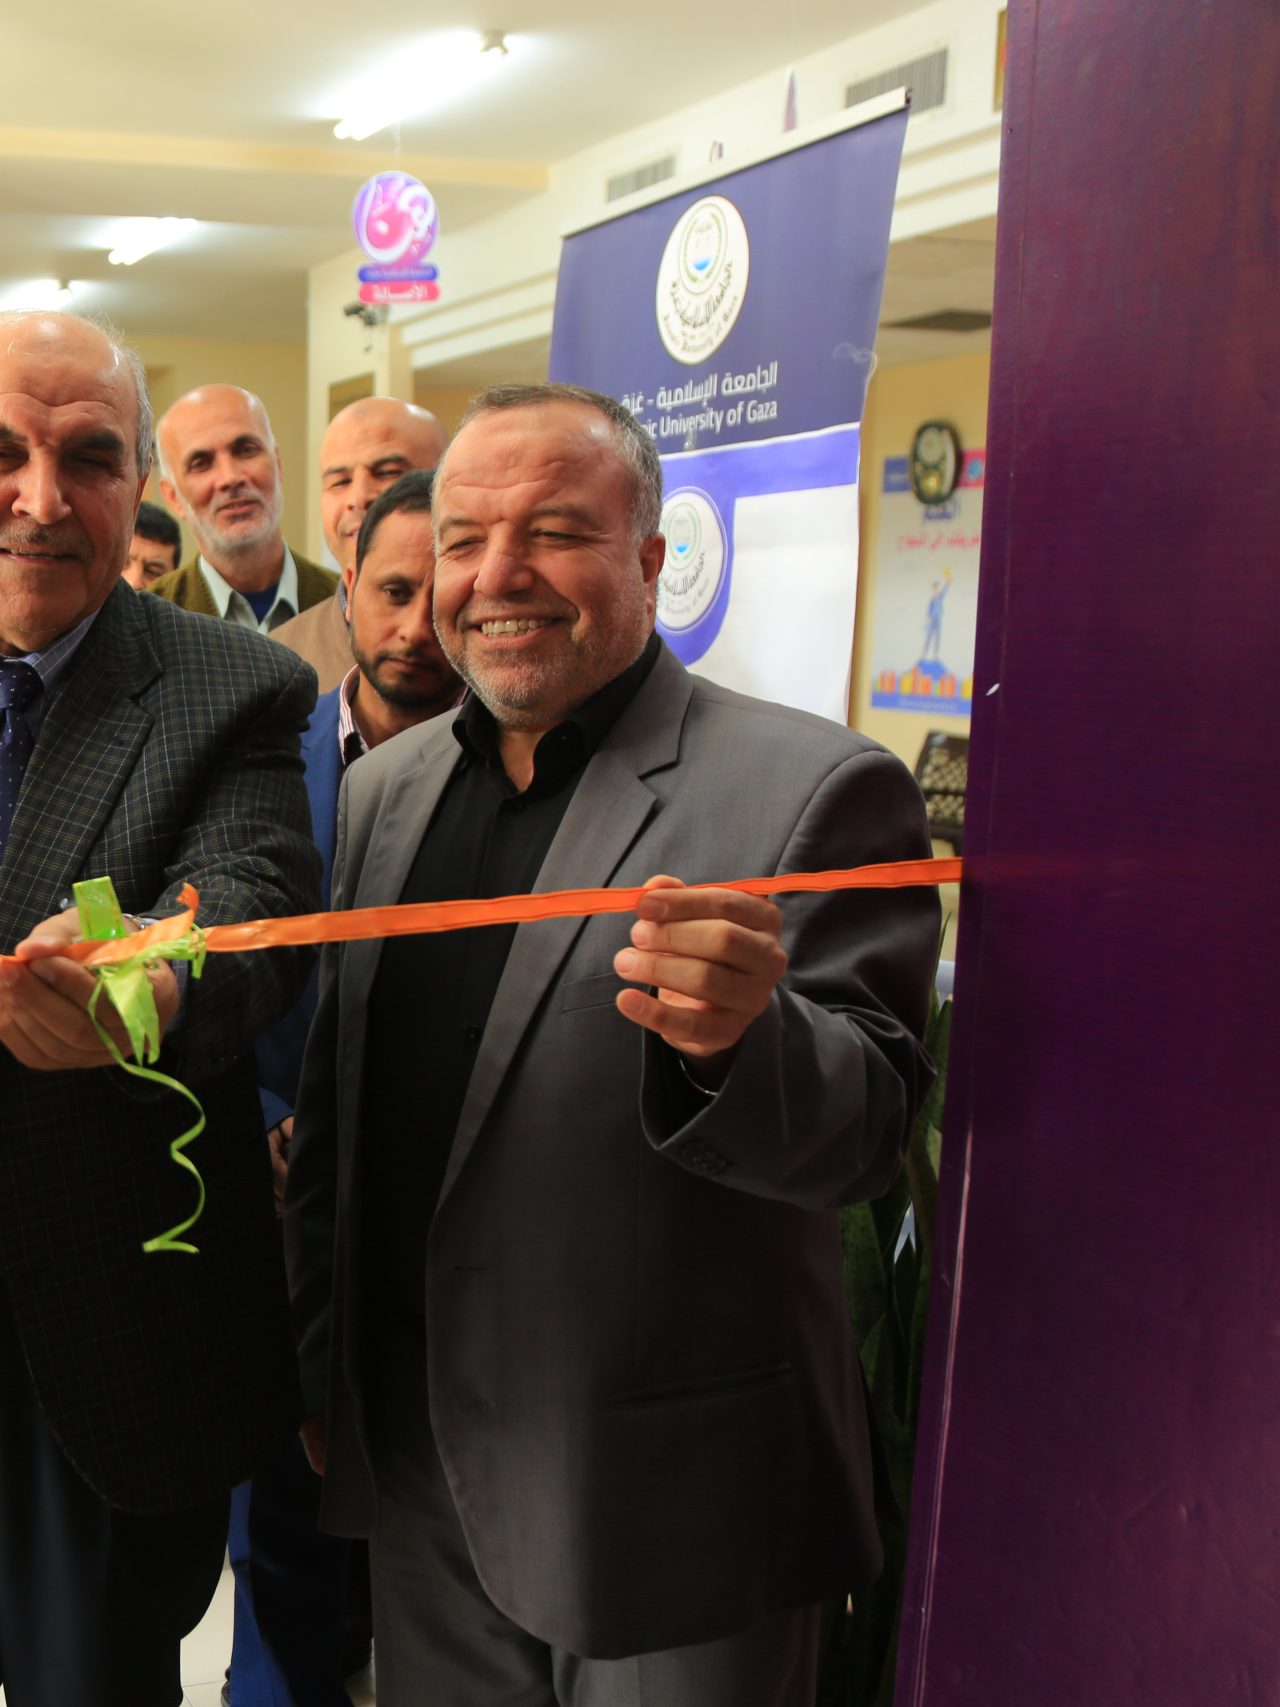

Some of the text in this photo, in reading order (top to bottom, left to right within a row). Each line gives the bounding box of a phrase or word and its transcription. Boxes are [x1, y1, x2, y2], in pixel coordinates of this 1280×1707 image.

[656, 373, 718, 413] الإسلامية
[720, 360, 778, 397] الجامعة
[659, 407, 723, 439] University
[726, 400, 744, 427] of
[746, 400, 777, 424] Gaza
